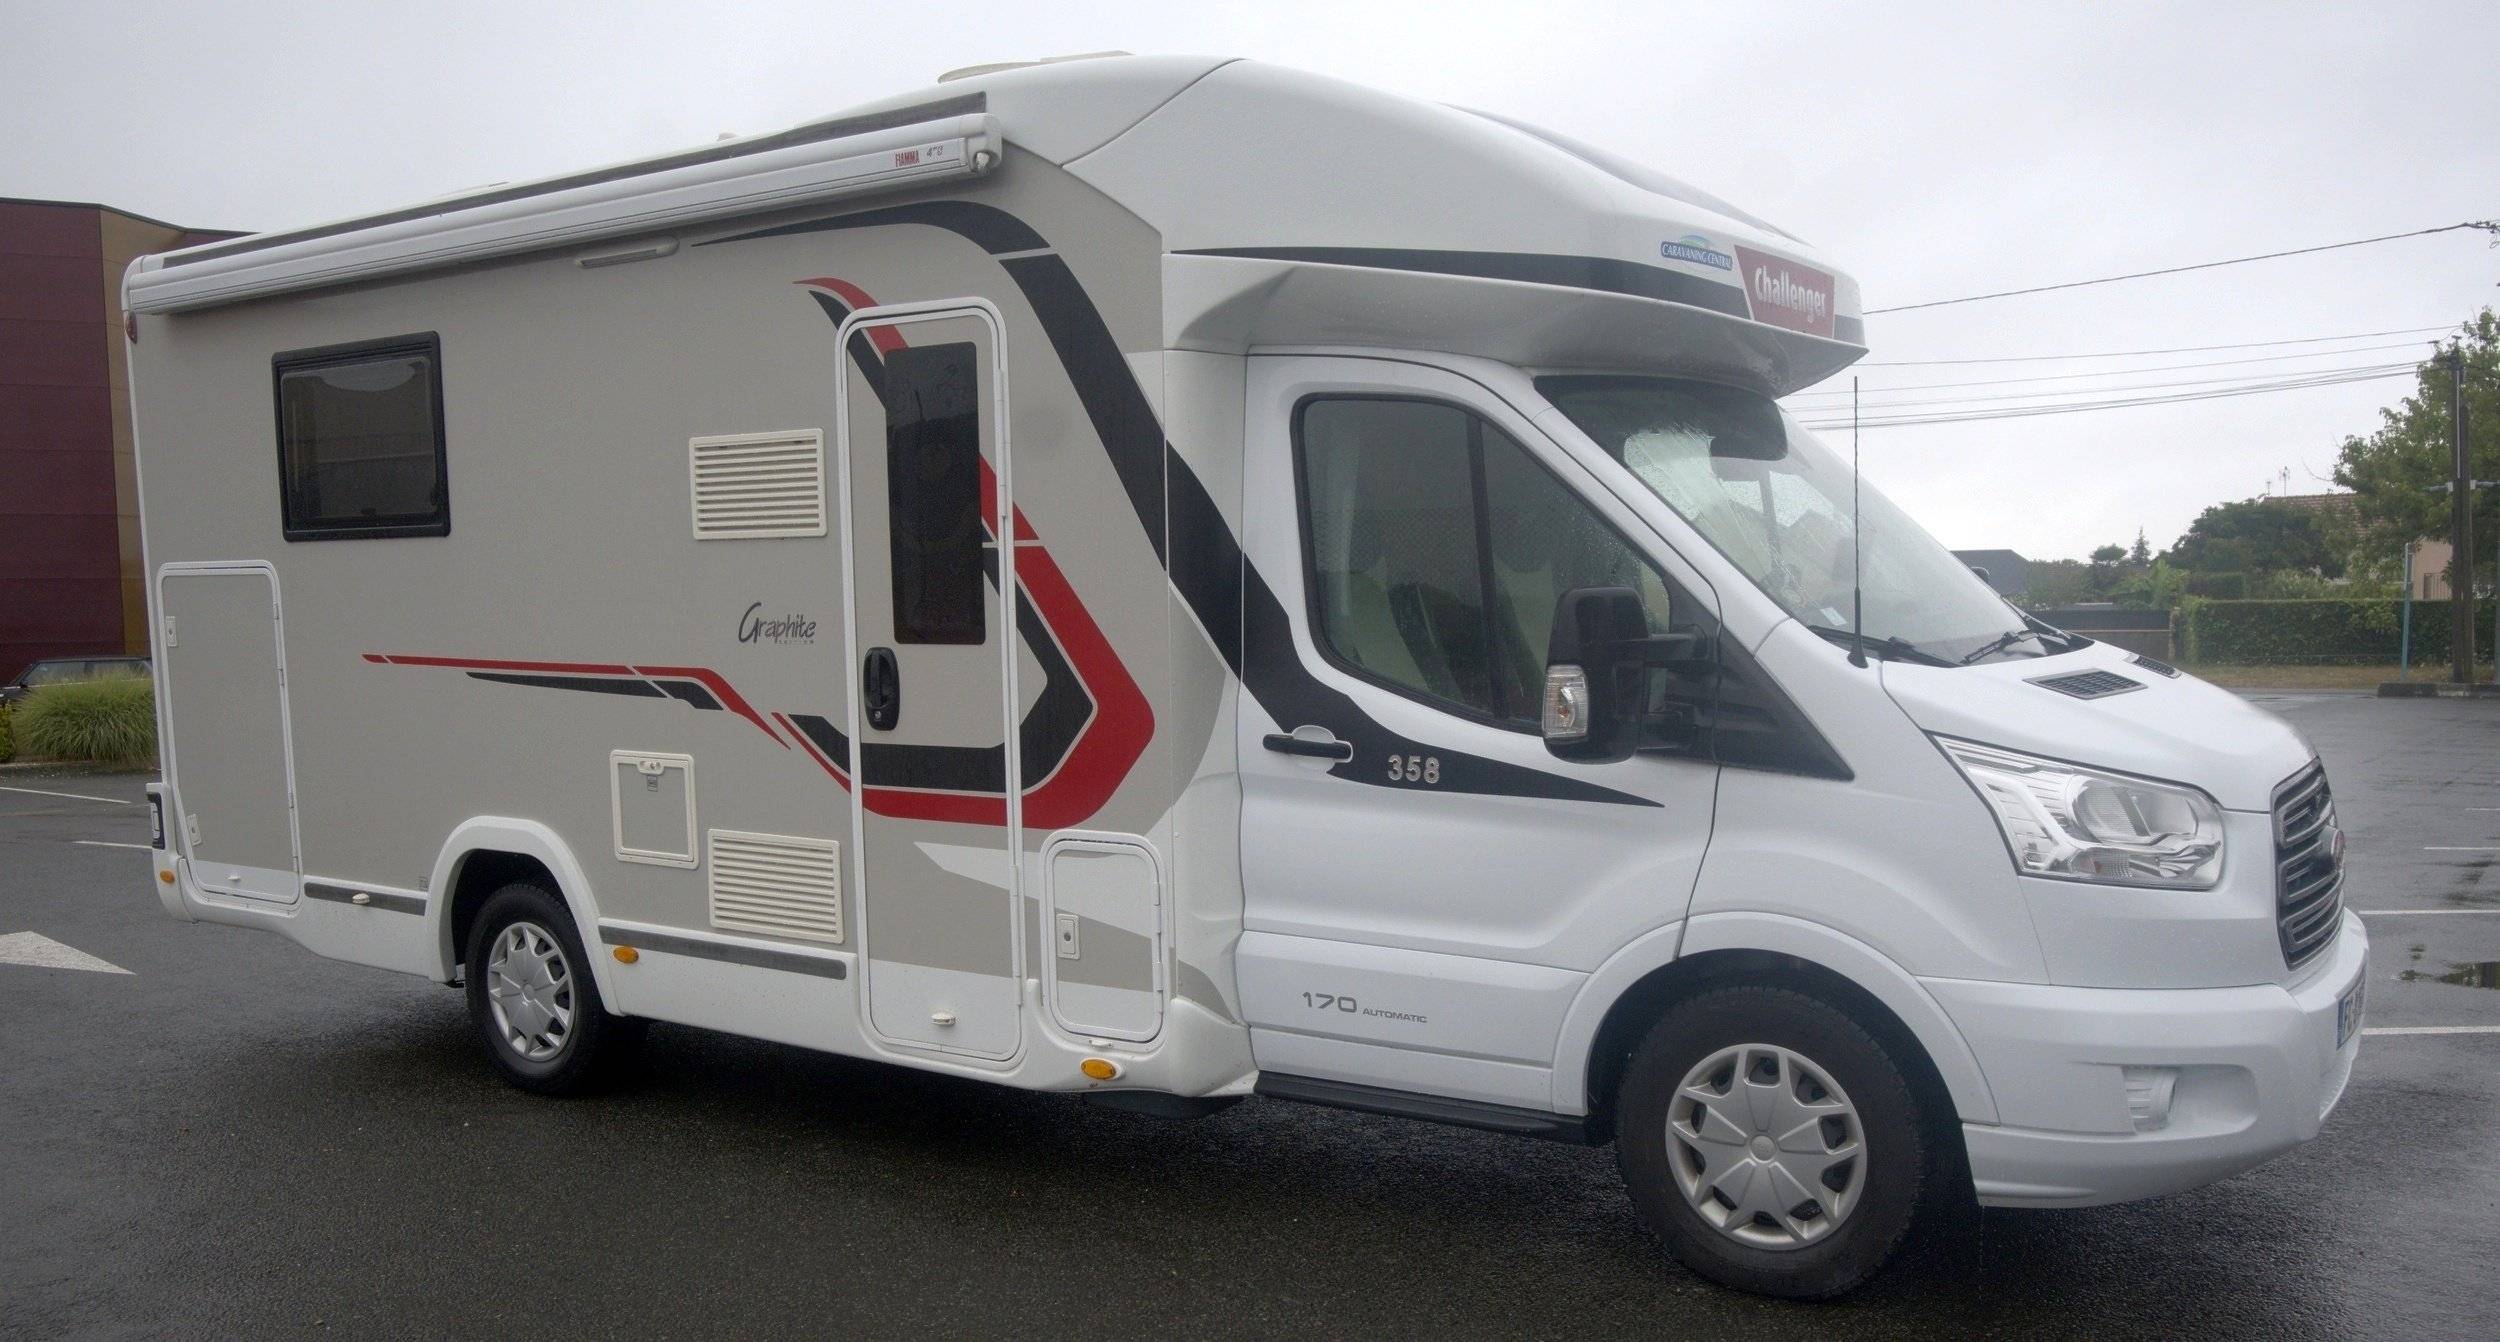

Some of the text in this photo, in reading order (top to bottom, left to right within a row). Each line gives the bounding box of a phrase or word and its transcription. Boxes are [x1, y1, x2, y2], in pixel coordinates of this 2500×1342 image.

[895, 149, 920, 168] FIAMMA
[1755, 267, 1826, 324] Challenger
[738, 601, 817, 644] Graphite
[1387, 754, 1440, 784] 358
[1302, 991, 1428, 1024] 170 AUTOMATIC
